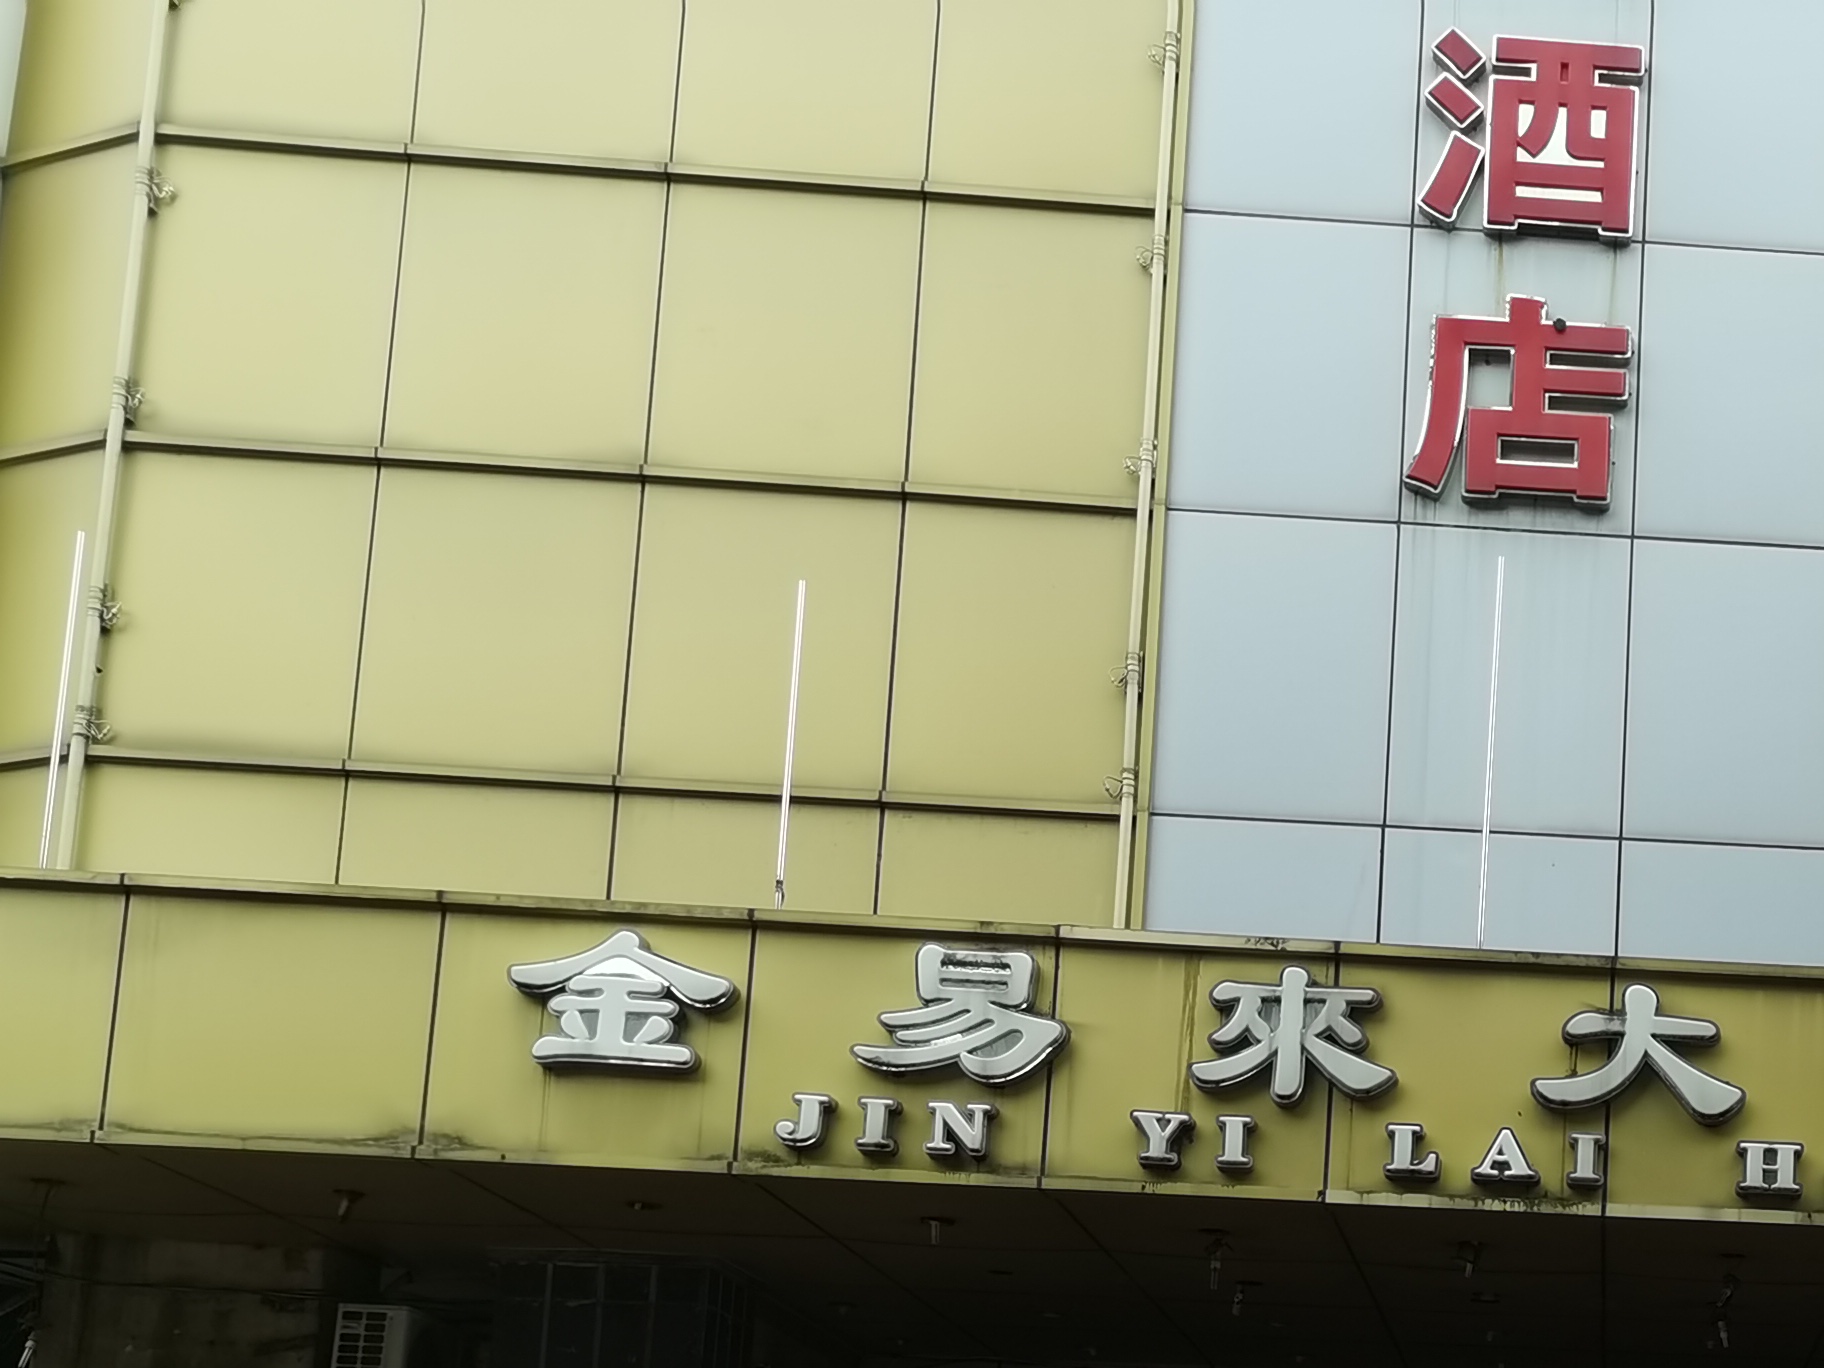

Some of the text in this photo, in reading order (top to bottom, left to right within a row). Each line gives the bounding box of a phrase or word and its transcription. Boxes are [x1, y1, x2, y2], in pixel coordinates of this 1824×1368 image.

[1404, 27, 1646, 510] 酒店
[773, 1092, 998, 1163] JIN
[1129, 1109, 1256, 1171] YI
[1383, 1122, 1606, 1193] LAI
